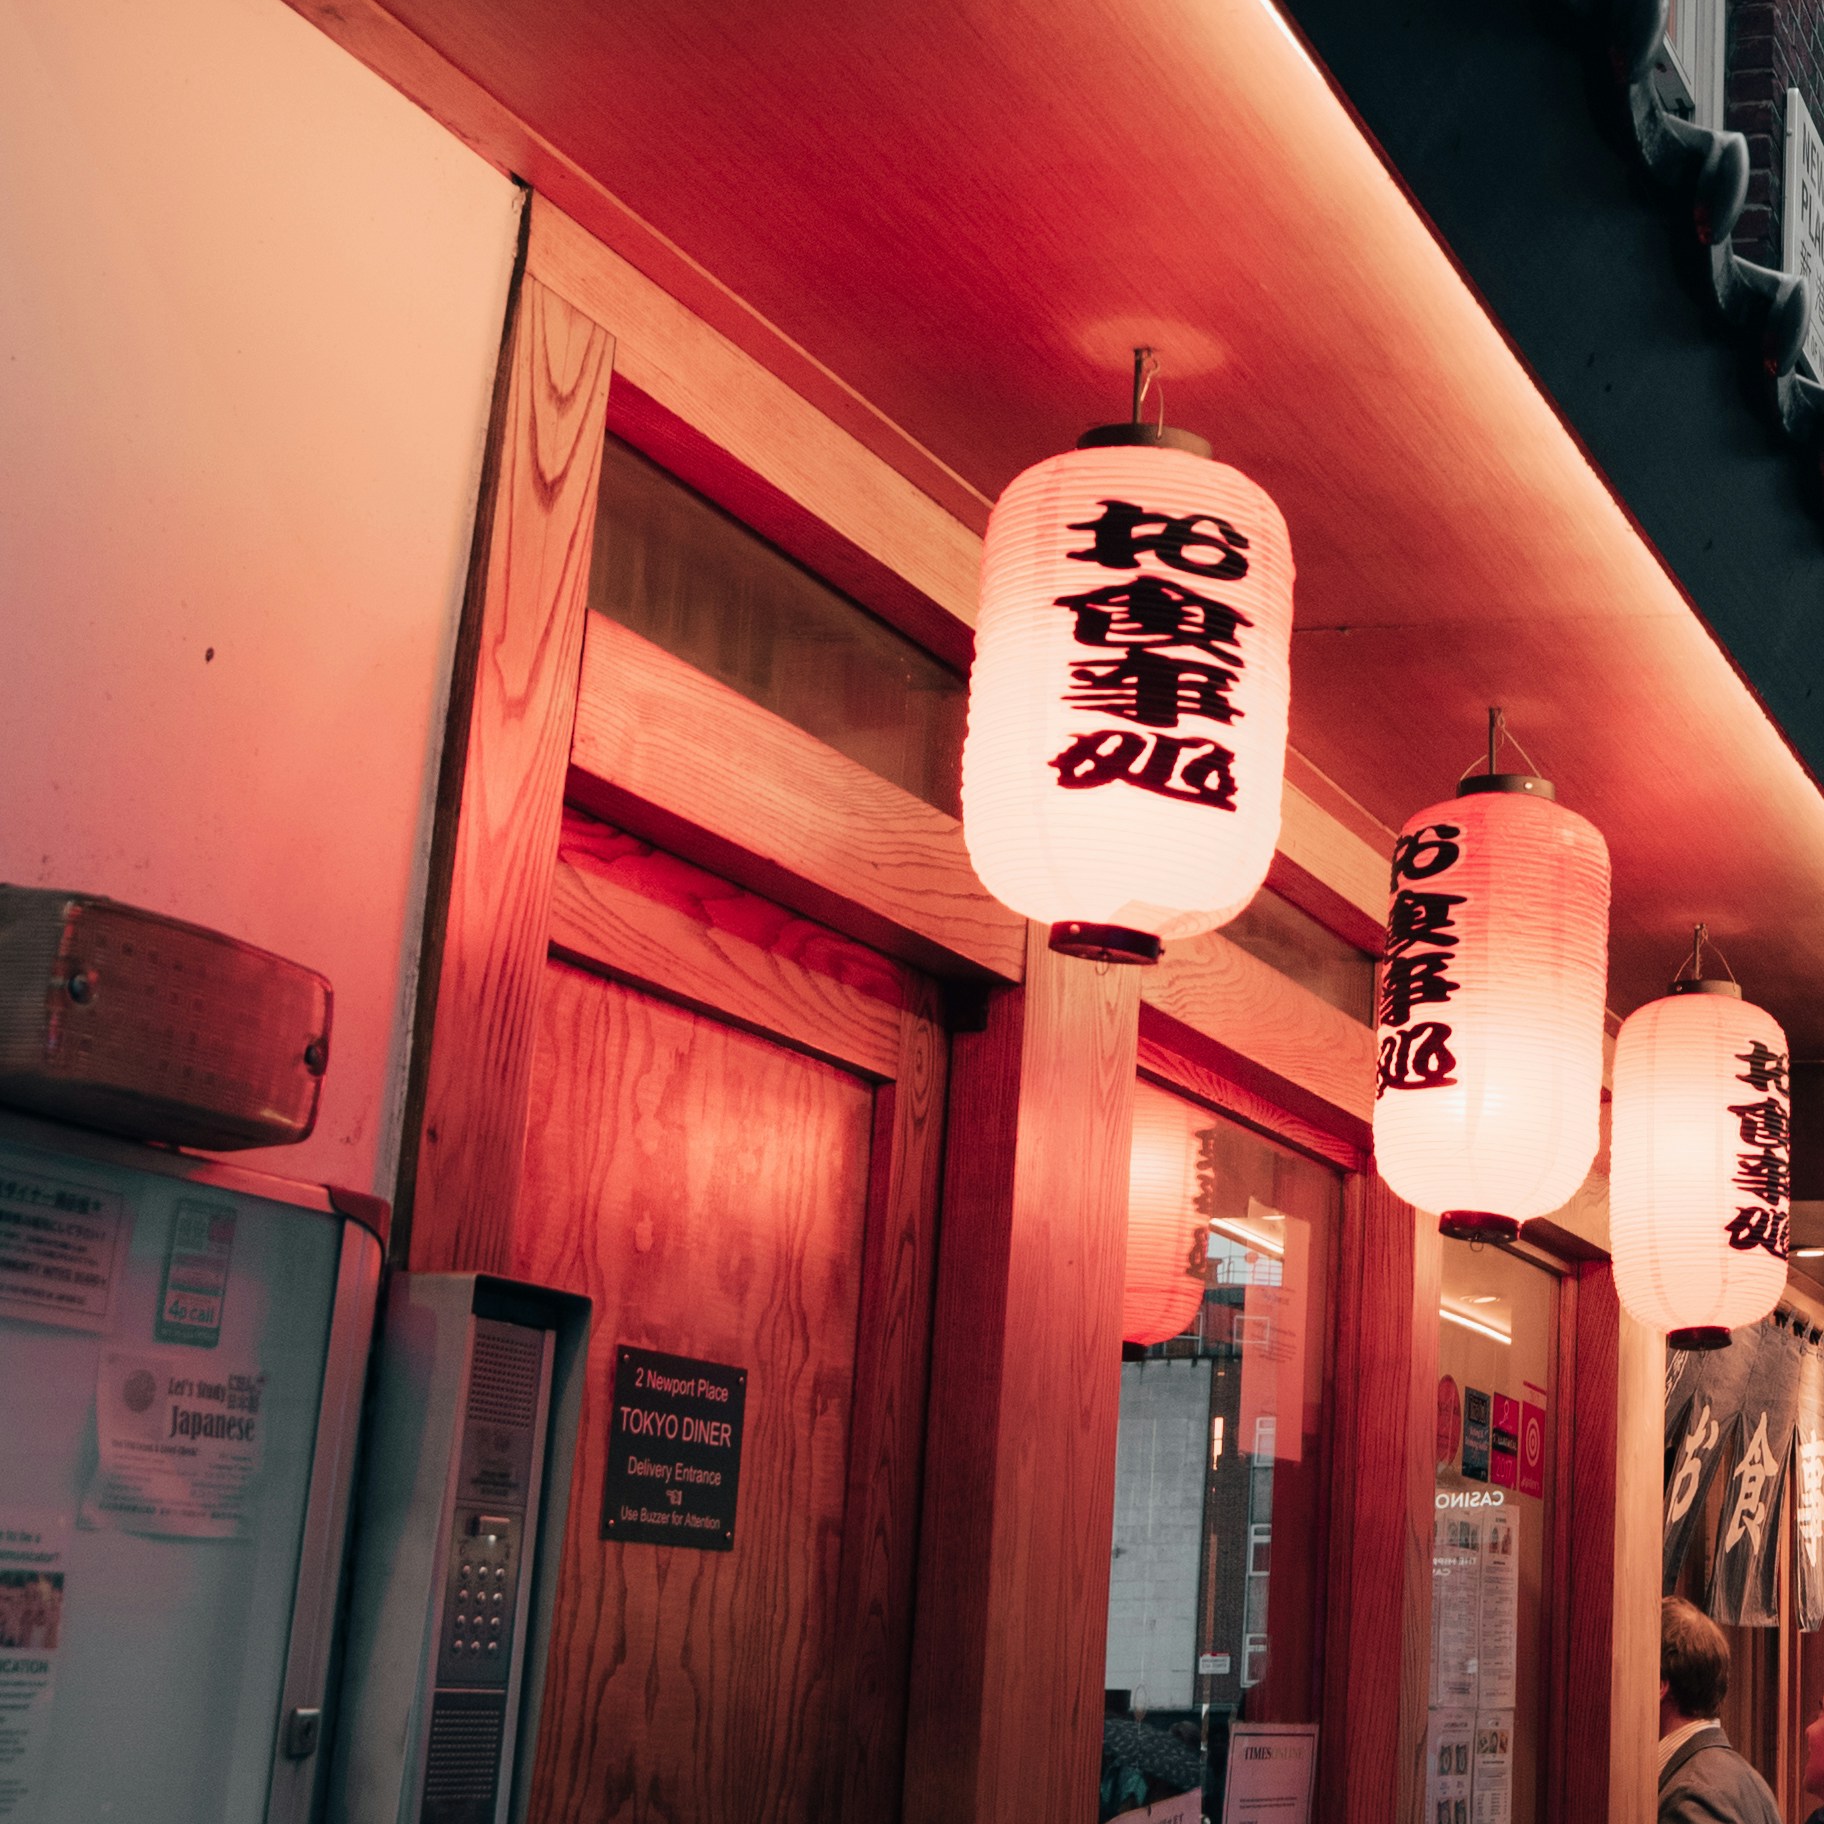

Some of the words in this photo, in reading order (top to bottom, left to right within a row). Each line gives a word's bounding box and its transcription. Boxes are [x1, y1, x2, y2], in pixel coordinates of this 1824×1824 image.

[635, 1367, 645, 1388] 2
[646, 1369, 695, 1398] Newport
[697, 1378, 729, 1402] Place
[168, 1404, 255, 1442] Japanese
[620, 1406, 679, 1440] TOKYO
[681, 1416, 732, 1448] DINER
[627, 1455, 673, 1483] Delivery
[674, 1462, 722, 1486] Entrance
[620, 1504, 639, 1521] Use
[640, 1507, 671, 1525] Buzzer
[671, 1510, 684, 1526] for
[683, 1512, 721, 1530] Attention
